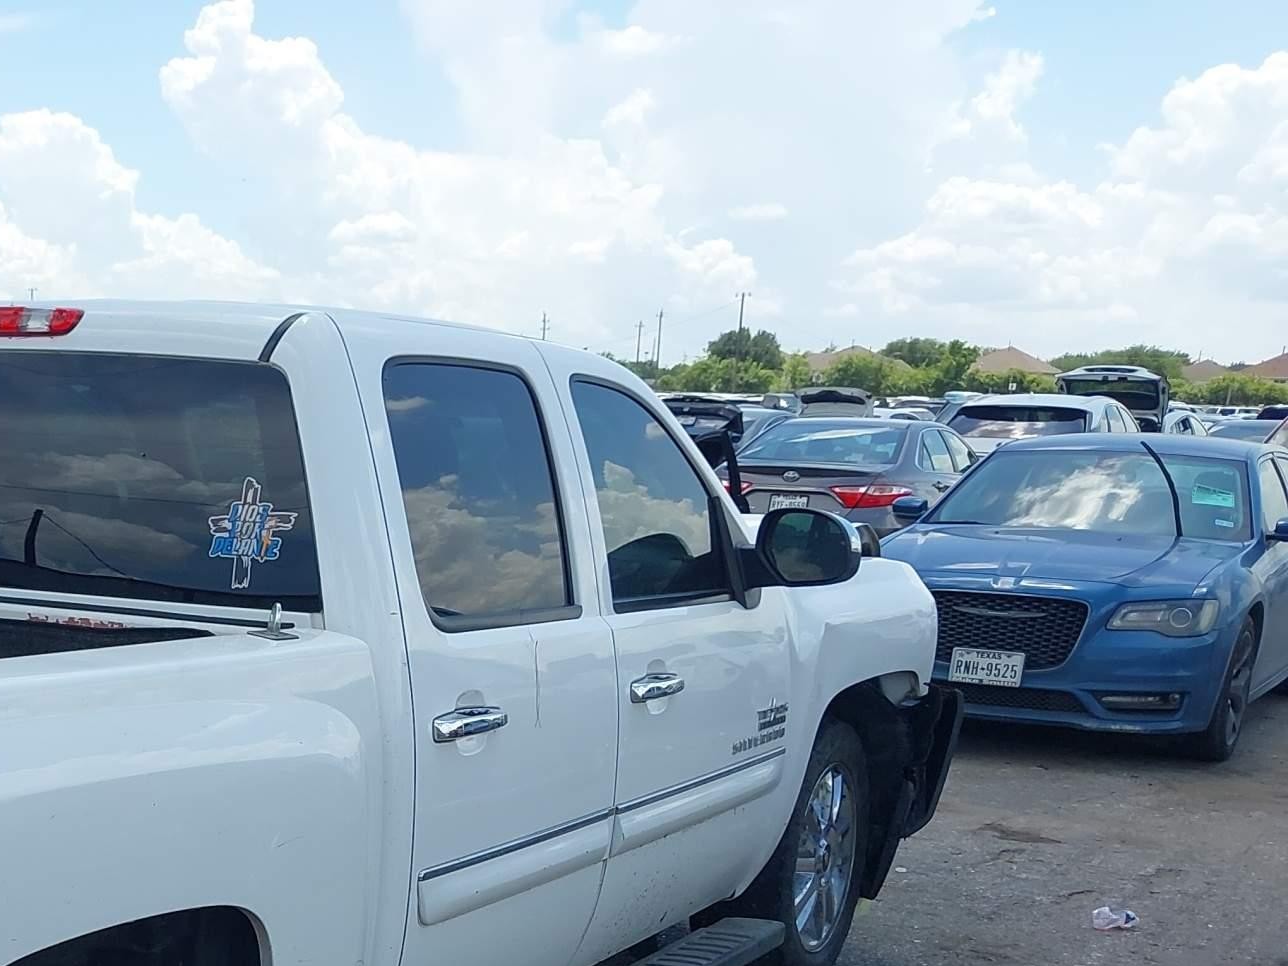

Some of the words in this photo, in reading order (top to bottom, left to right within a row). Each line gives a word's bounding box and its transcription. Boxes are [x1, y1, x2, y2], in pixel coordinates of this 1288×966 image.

[229, 503, 270, 522] DIOS
[228, 521, 267, 539] POR
[974, 651, 1002, 660] TEXAS
[954, 659, 1019, 680] RNH-9525
